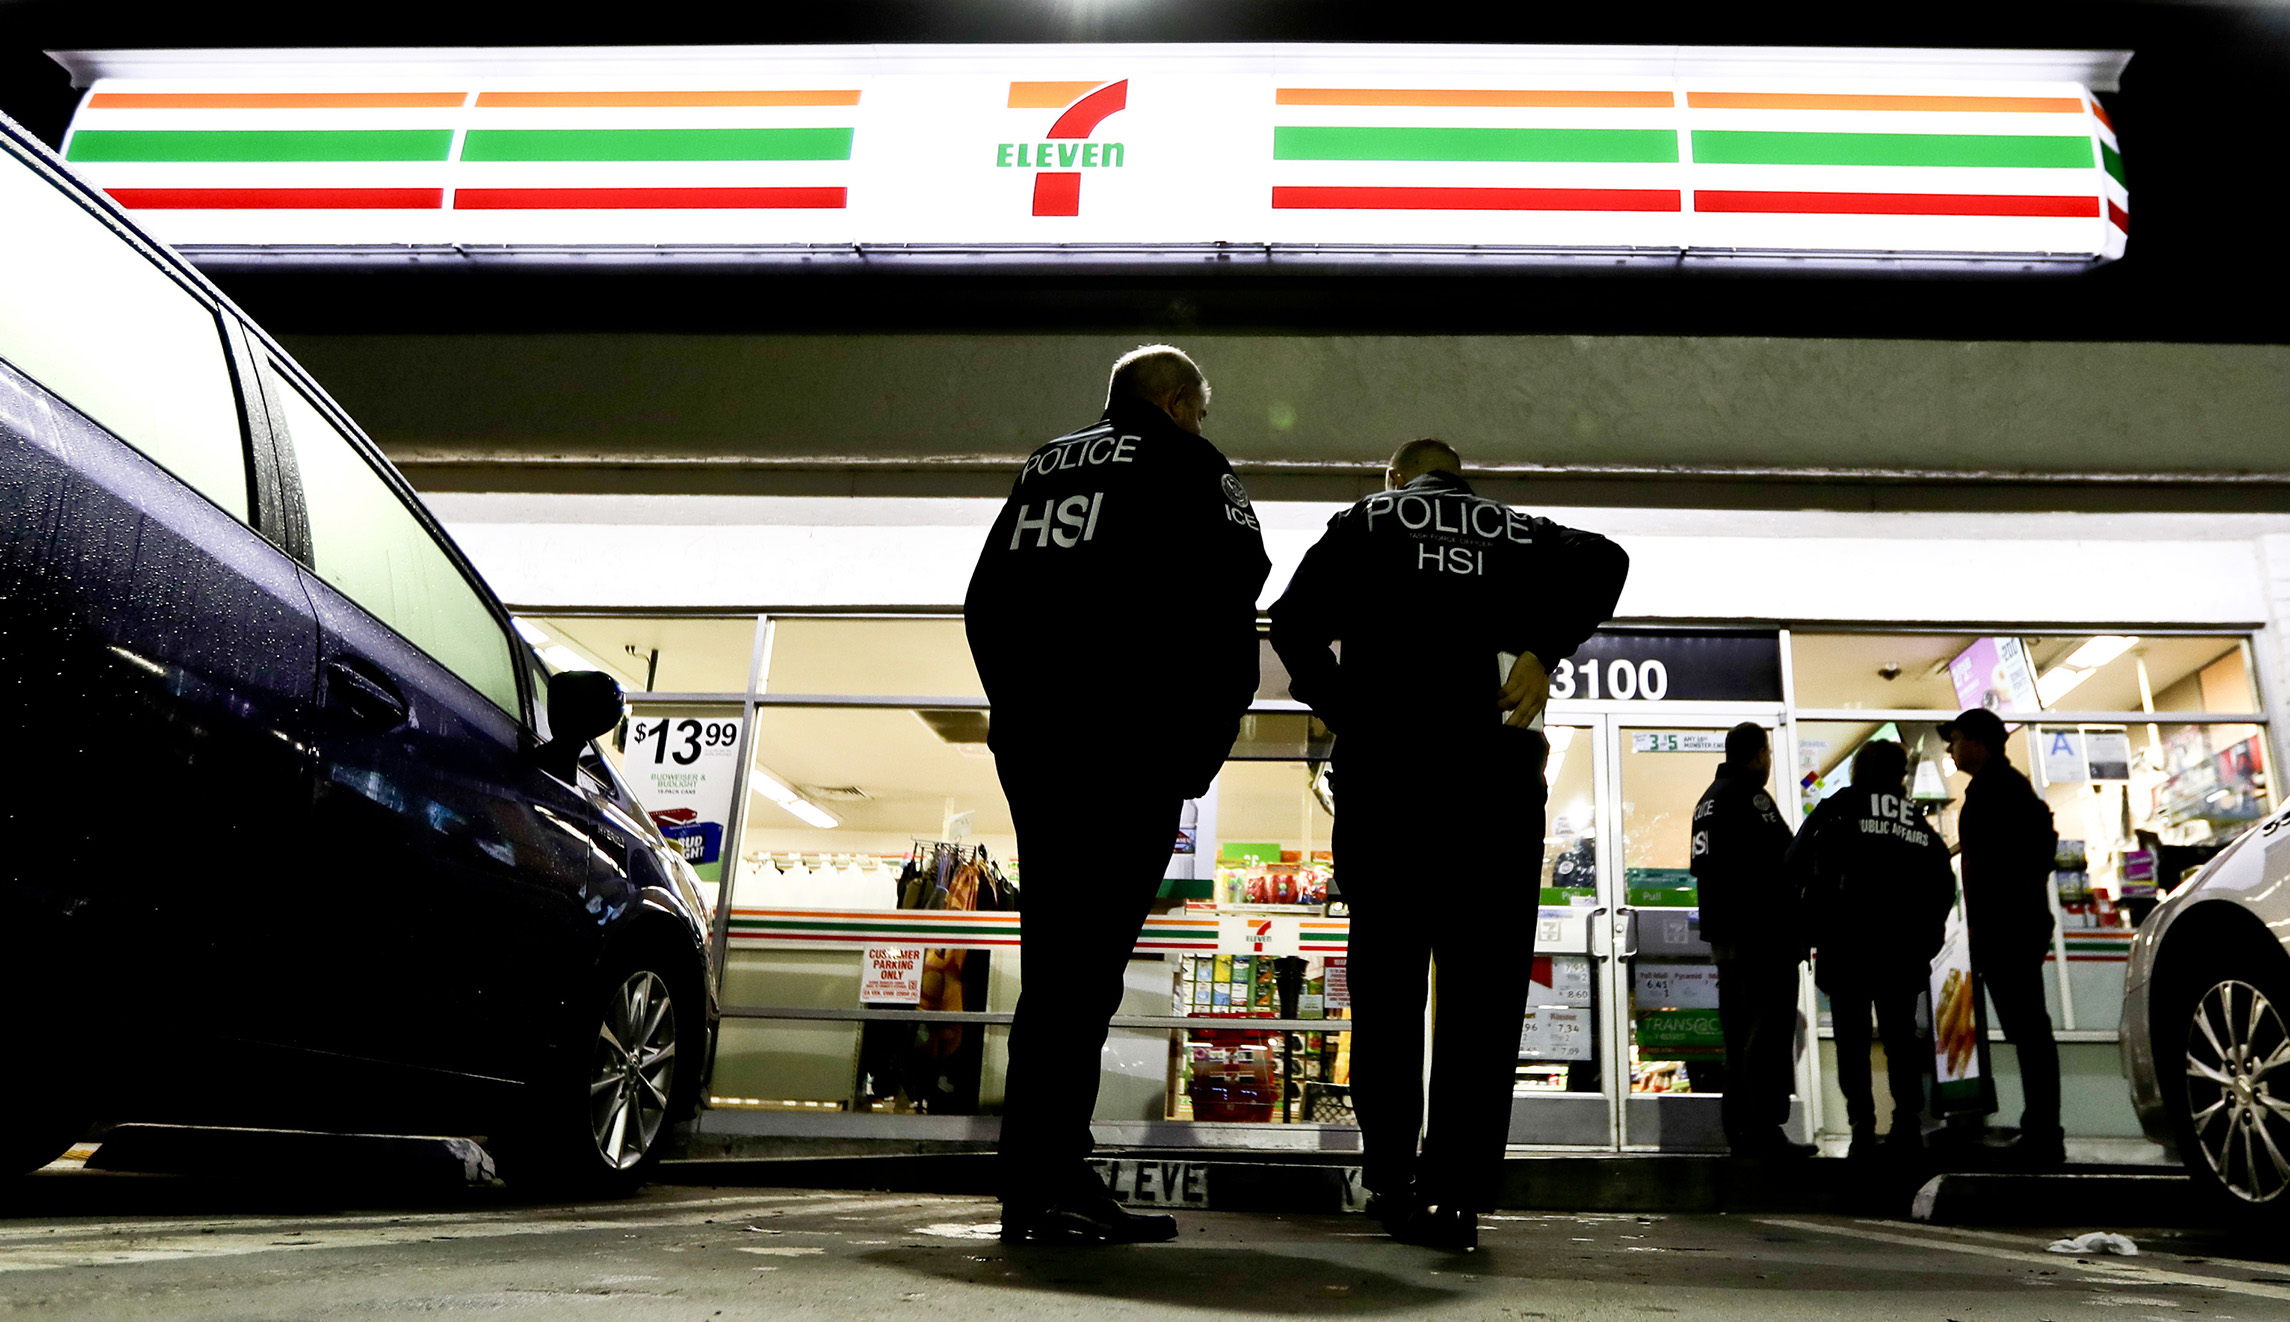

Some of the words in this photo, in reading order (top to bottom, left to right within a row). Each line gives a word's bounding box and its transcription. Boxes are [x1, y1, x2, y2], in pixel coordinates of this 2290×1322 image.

[1007, 78, 1128, 216] 7
[1021, 435, 1142, 484] POLICE
[1010, 492, 1104, 550] HSI
[1224, 504, 1260, 531] ICE
[1367, 496, 1533, 544] POLICE
[1418, 542, 1483, 575] HSI
[1550, 658, 1669, 700] 3100
[1650, 734, 1659, 751] 3
[2051, 731, 2074, 756] A
[651, 773, 699, 781] BUDWEISER
[1871, 793, 1915, 826] ICE
[1859, 819, 1890, 834] UBLIC
[1892, 822, 1929, 847] AFFAIRS
[1642, 891, 1662, 901] Pull
[1247, 919, 1272, 952] 7
[869, 949, 920, 960] CUSMER
[873, 960, 914, 970] PARKING
[881, 970, 904, 980] ONLY
[1646, 1018, 1723, 1035] TRANS@C
